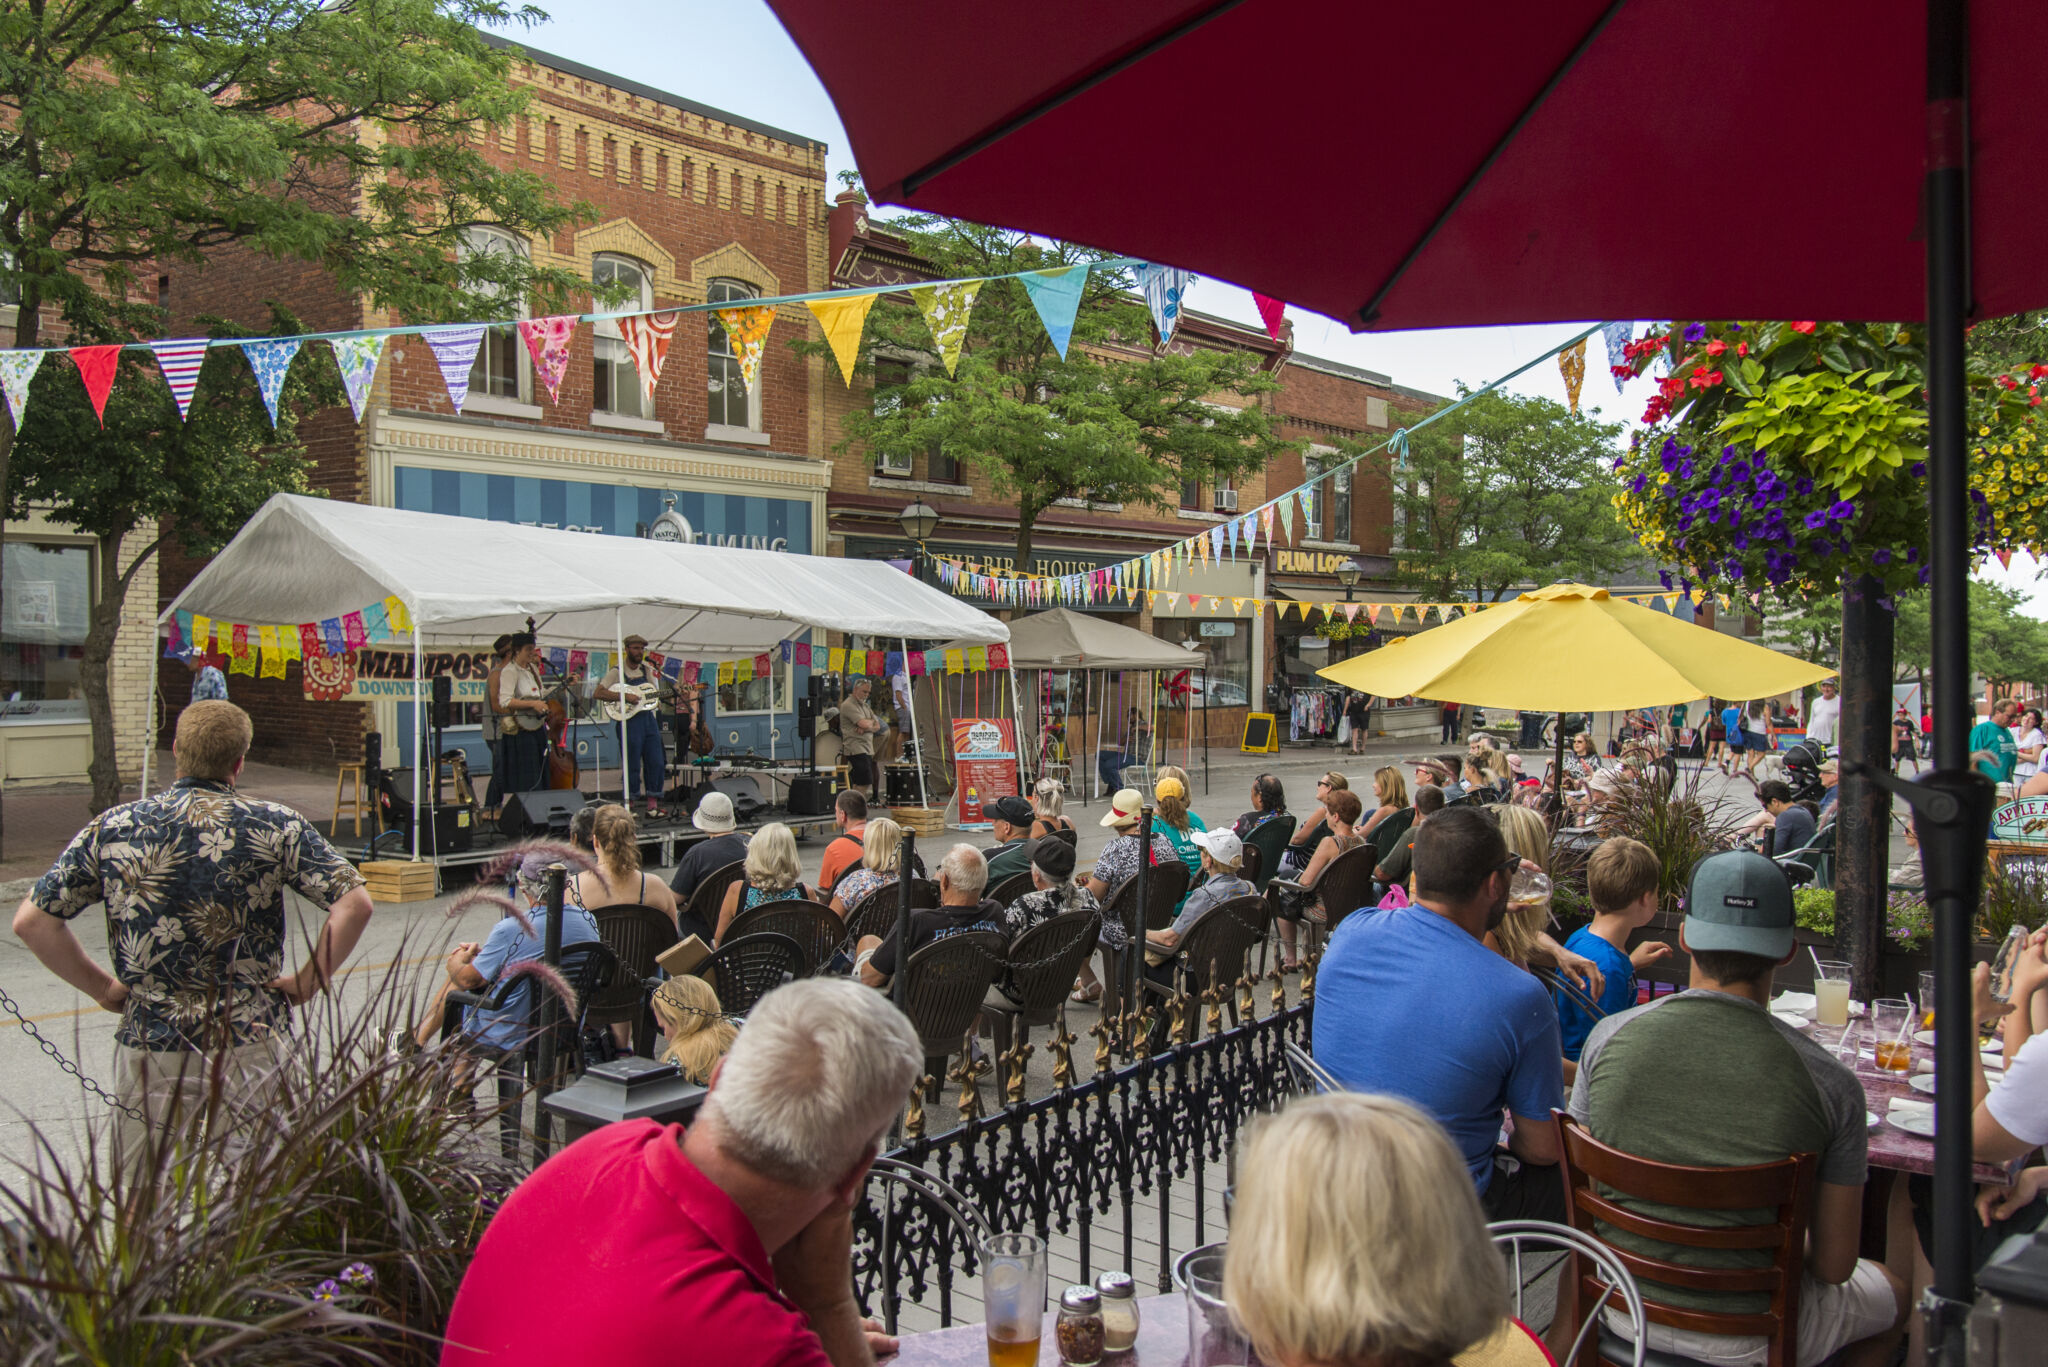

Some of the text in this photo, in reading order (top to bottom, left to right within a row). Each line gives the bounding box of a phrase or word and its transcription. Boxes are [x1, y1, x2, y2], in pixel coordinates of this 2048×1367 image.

[982, 555, 1015, 577] BIR
[1036, 559, 1097, 578] HOUSE
[1277, 550, 1315, 573] PLUM
[358, 650, 497, 680] MARIPOS
[458, 681, 487, 696] STA
[1997, 801, 2038, 825] APPLE
